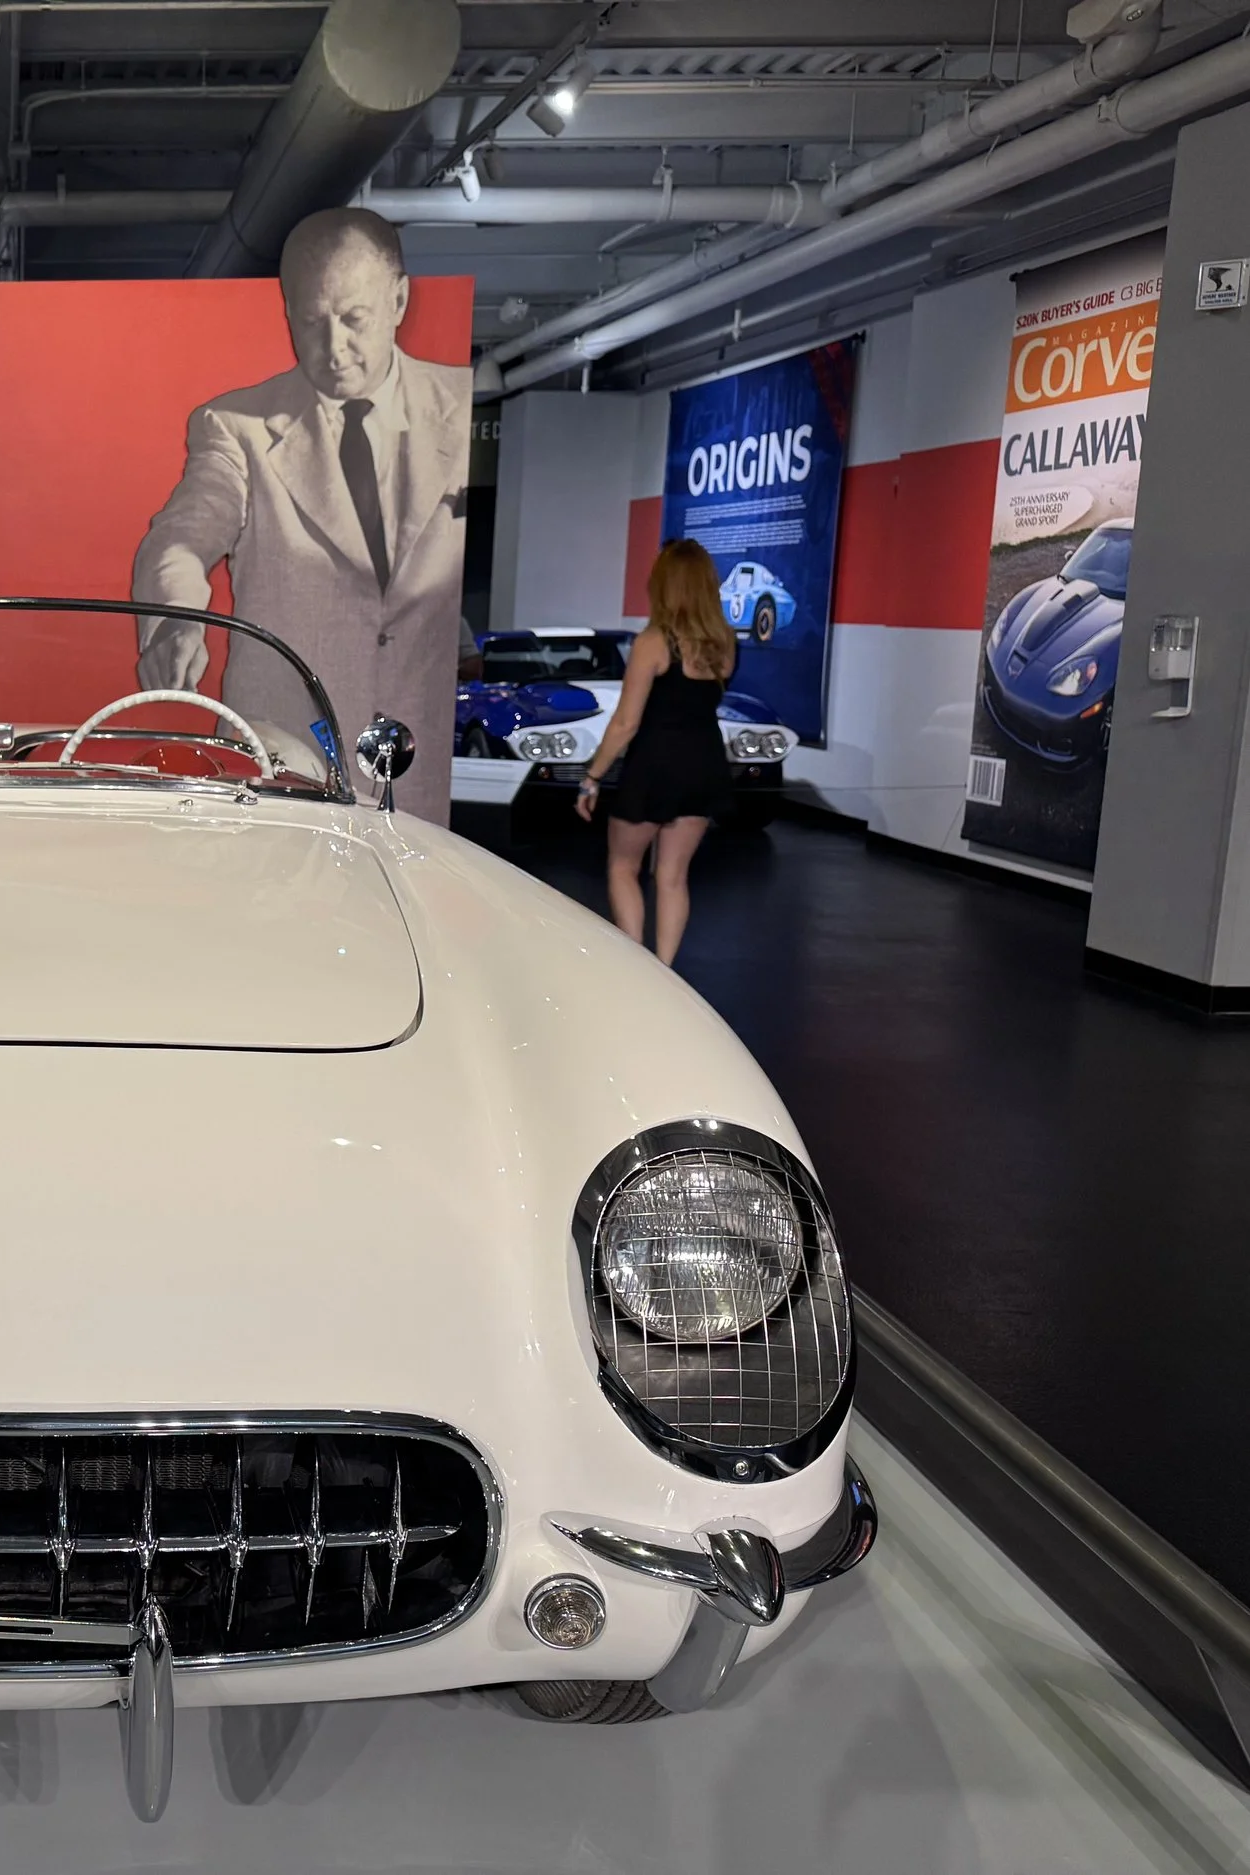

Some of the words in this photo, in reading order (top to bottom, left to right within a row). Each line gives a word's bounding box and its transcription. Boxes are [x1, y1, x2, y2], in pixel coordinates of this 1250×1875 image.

[1041, 299, 1081, 323] BUYER'S
[1083, 290, 1115, 312] GUIDE
[1136, 279, 1153, 297] BIG
[1014, 325, 1157, 403] Corve
[688, 424, 813, 497] ORIGINS
[1014, 503, 1063, 517] SUPERCHARGED
[1026, 491, 1070, 504] ANNIVERSARY
[1015, 516, 1037, 528] GRAND
[1038, 514, 1059, 526] SPORT
